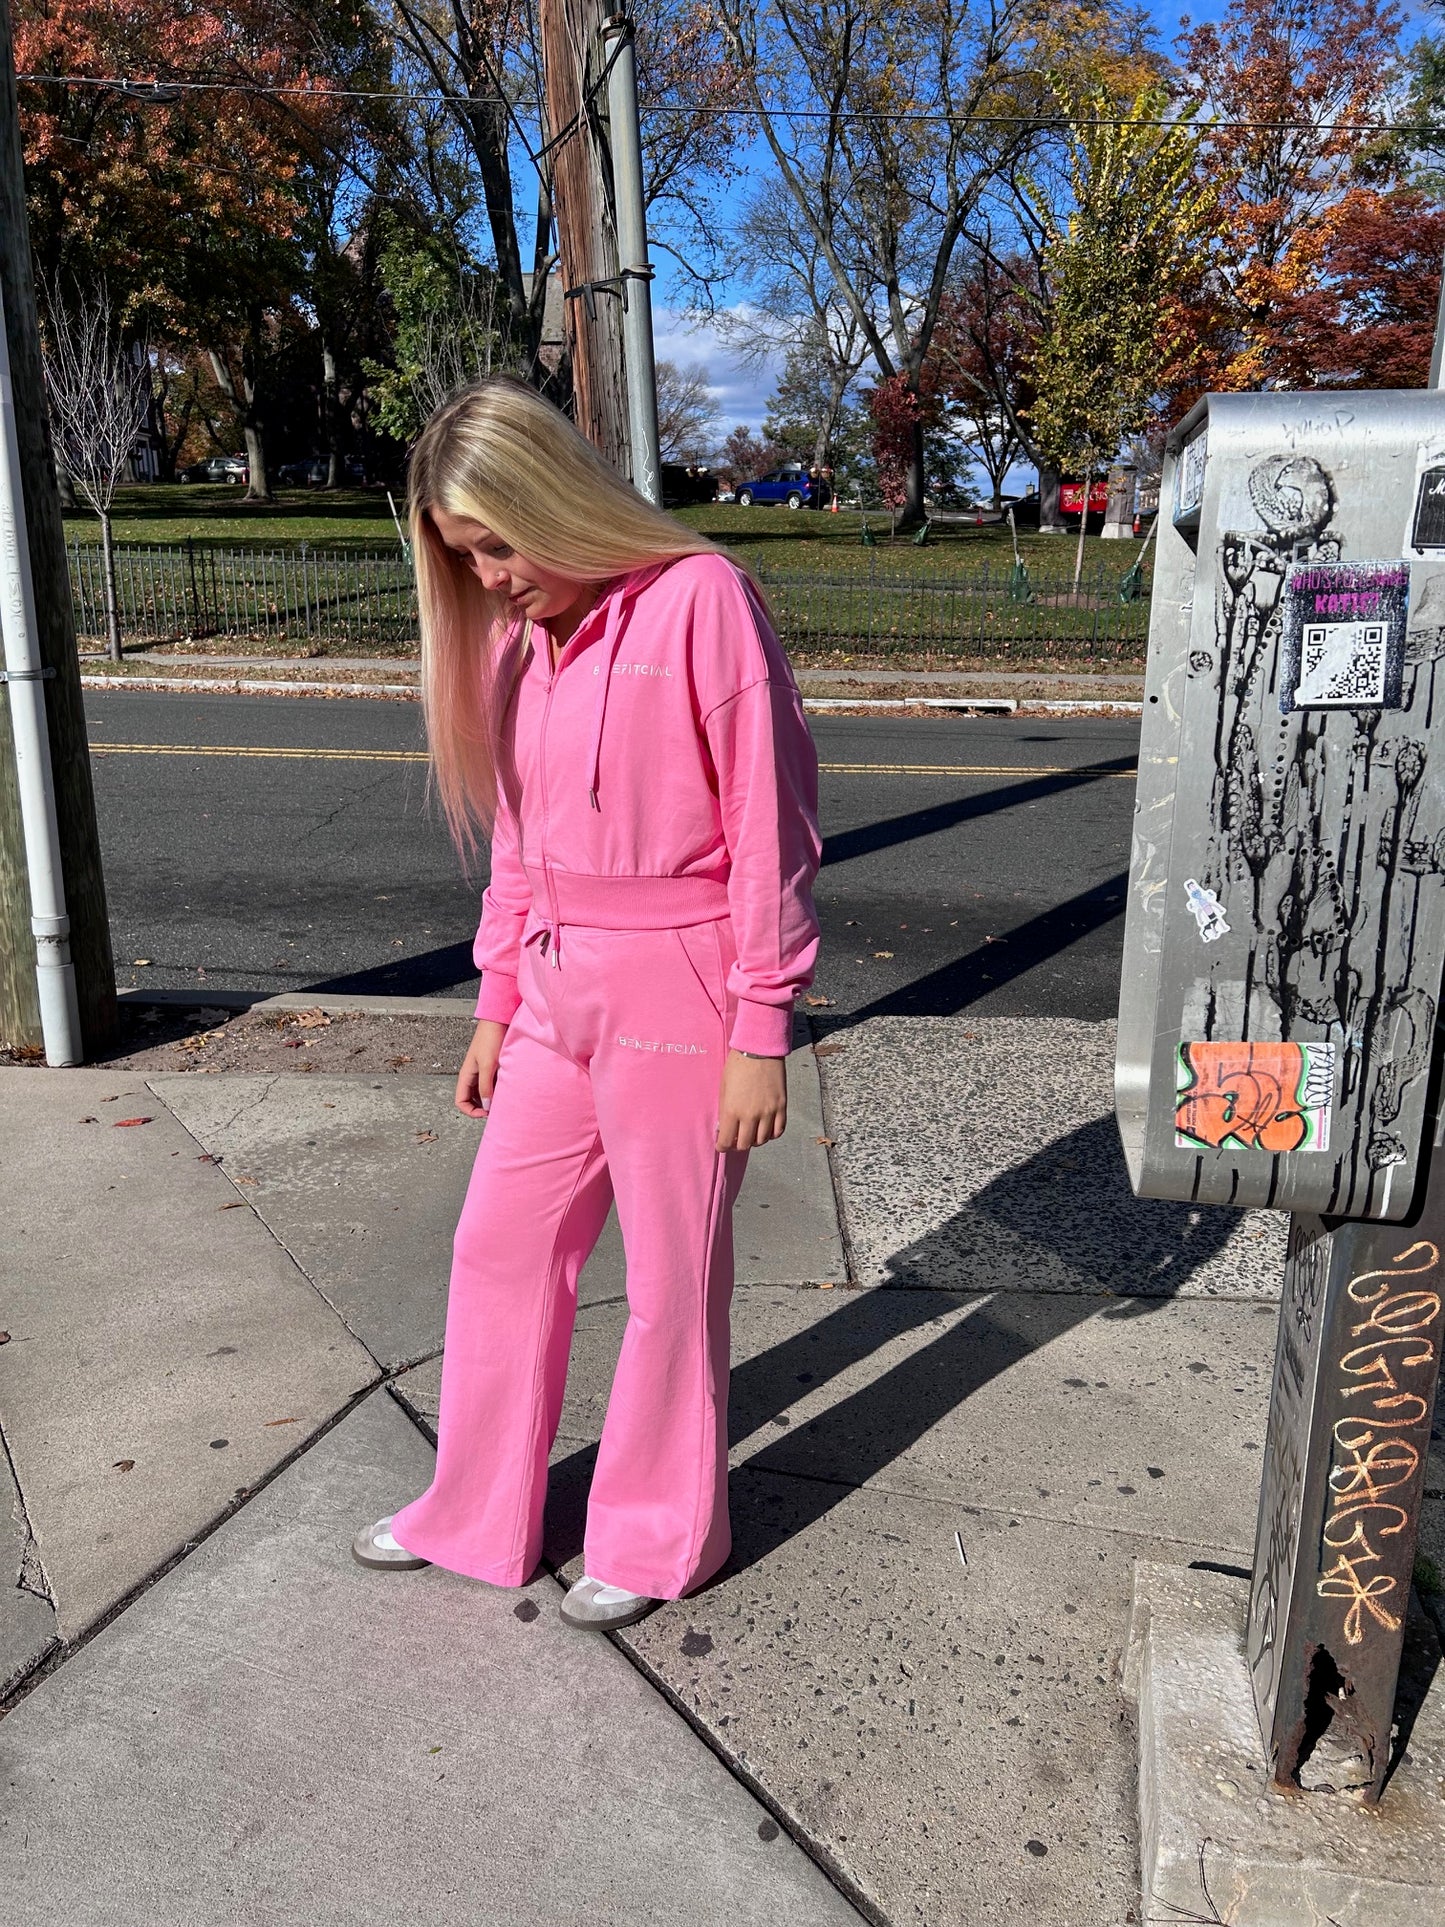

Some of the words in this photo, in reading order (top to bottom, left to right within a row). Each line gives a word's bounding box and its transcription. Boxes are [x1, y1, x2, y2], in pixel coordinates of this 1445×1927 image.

[1315, 592, 1379, 614] KATIE?
[593, 663, 672, 677] BEFITCIAL
[618, 1036, 708, 1054] BENEFITCIAL
